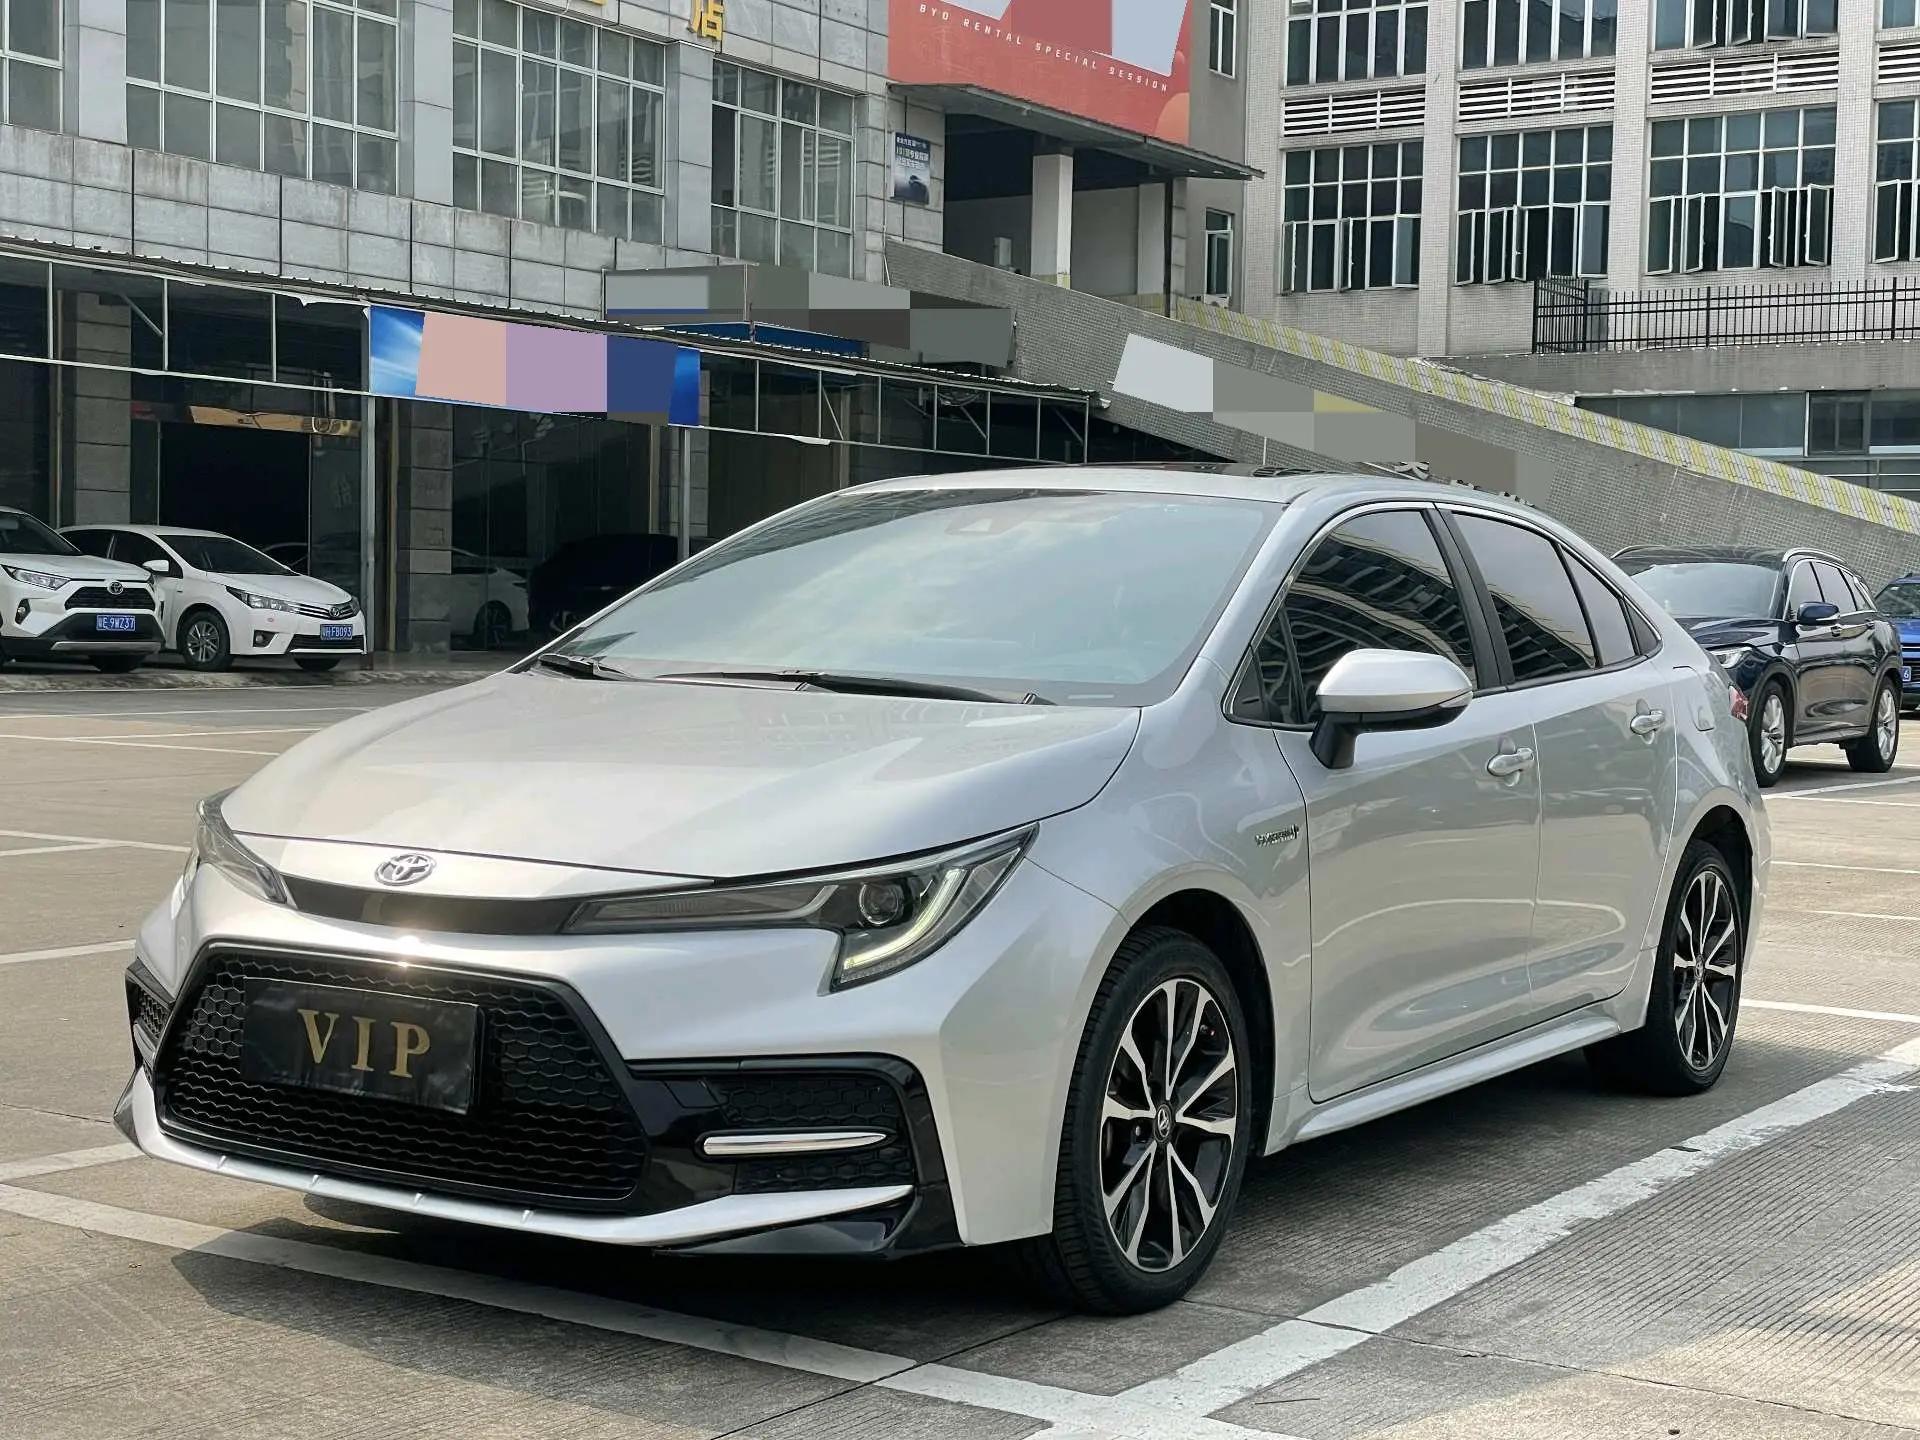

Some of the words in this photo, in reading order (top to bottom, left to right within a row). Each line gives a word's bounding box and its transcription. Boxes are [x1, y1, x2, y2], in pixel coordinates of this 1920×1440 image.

[963, 18, 1021, 45] RENTAL
[1035, 42, 1096, 69] SPECIAL
[1109, 66, 1167, 92] SESSION
[297, 1008, 431, 1079] VIP
